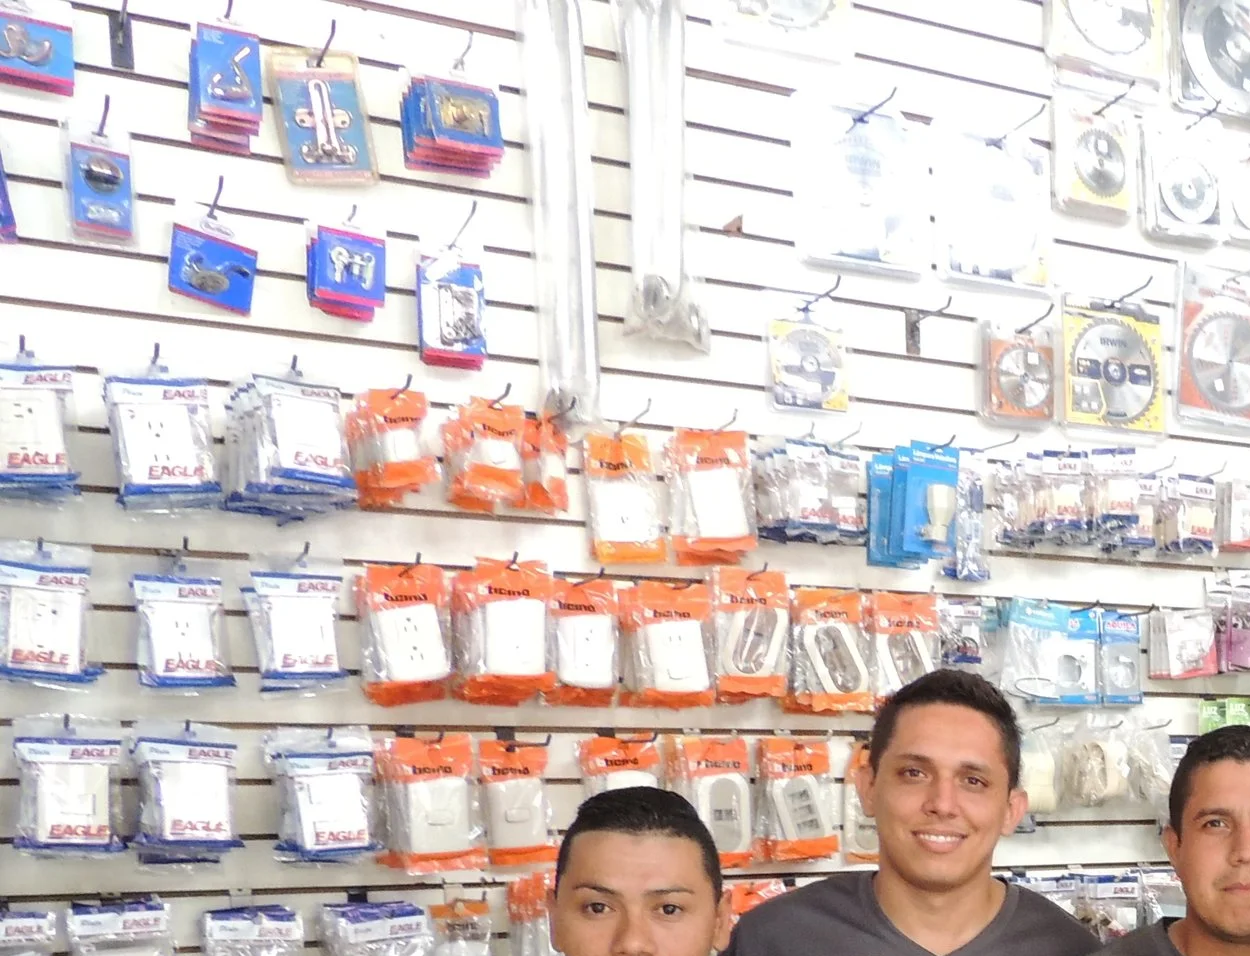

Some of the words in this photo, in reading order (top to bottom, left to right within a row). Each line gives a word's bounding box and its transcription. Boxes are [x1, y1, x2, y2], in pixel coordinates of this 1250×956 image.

[1100, 337, 1127, 347] IRWIN
[24, 372, 72, 384] EAGLE
[163, 389, 207, 400] EAGLE
[7, 453, 66, 467] EAGLE
[149, 465, 206, 479] EAGLE
[37, 575, 87, 586] EAGLE
[297, 582, 341, 593] EAGLE
[70, 748, 120, 759] EAGLE
[188, 748, 232, 759] EAGLE
[50, 824, 109, 838] EAGLE
[315, 830, 366, 844] EAGLE
[122, 917, 161, 929] EAGLE
[390, 922, 422, 935] EAGLE
